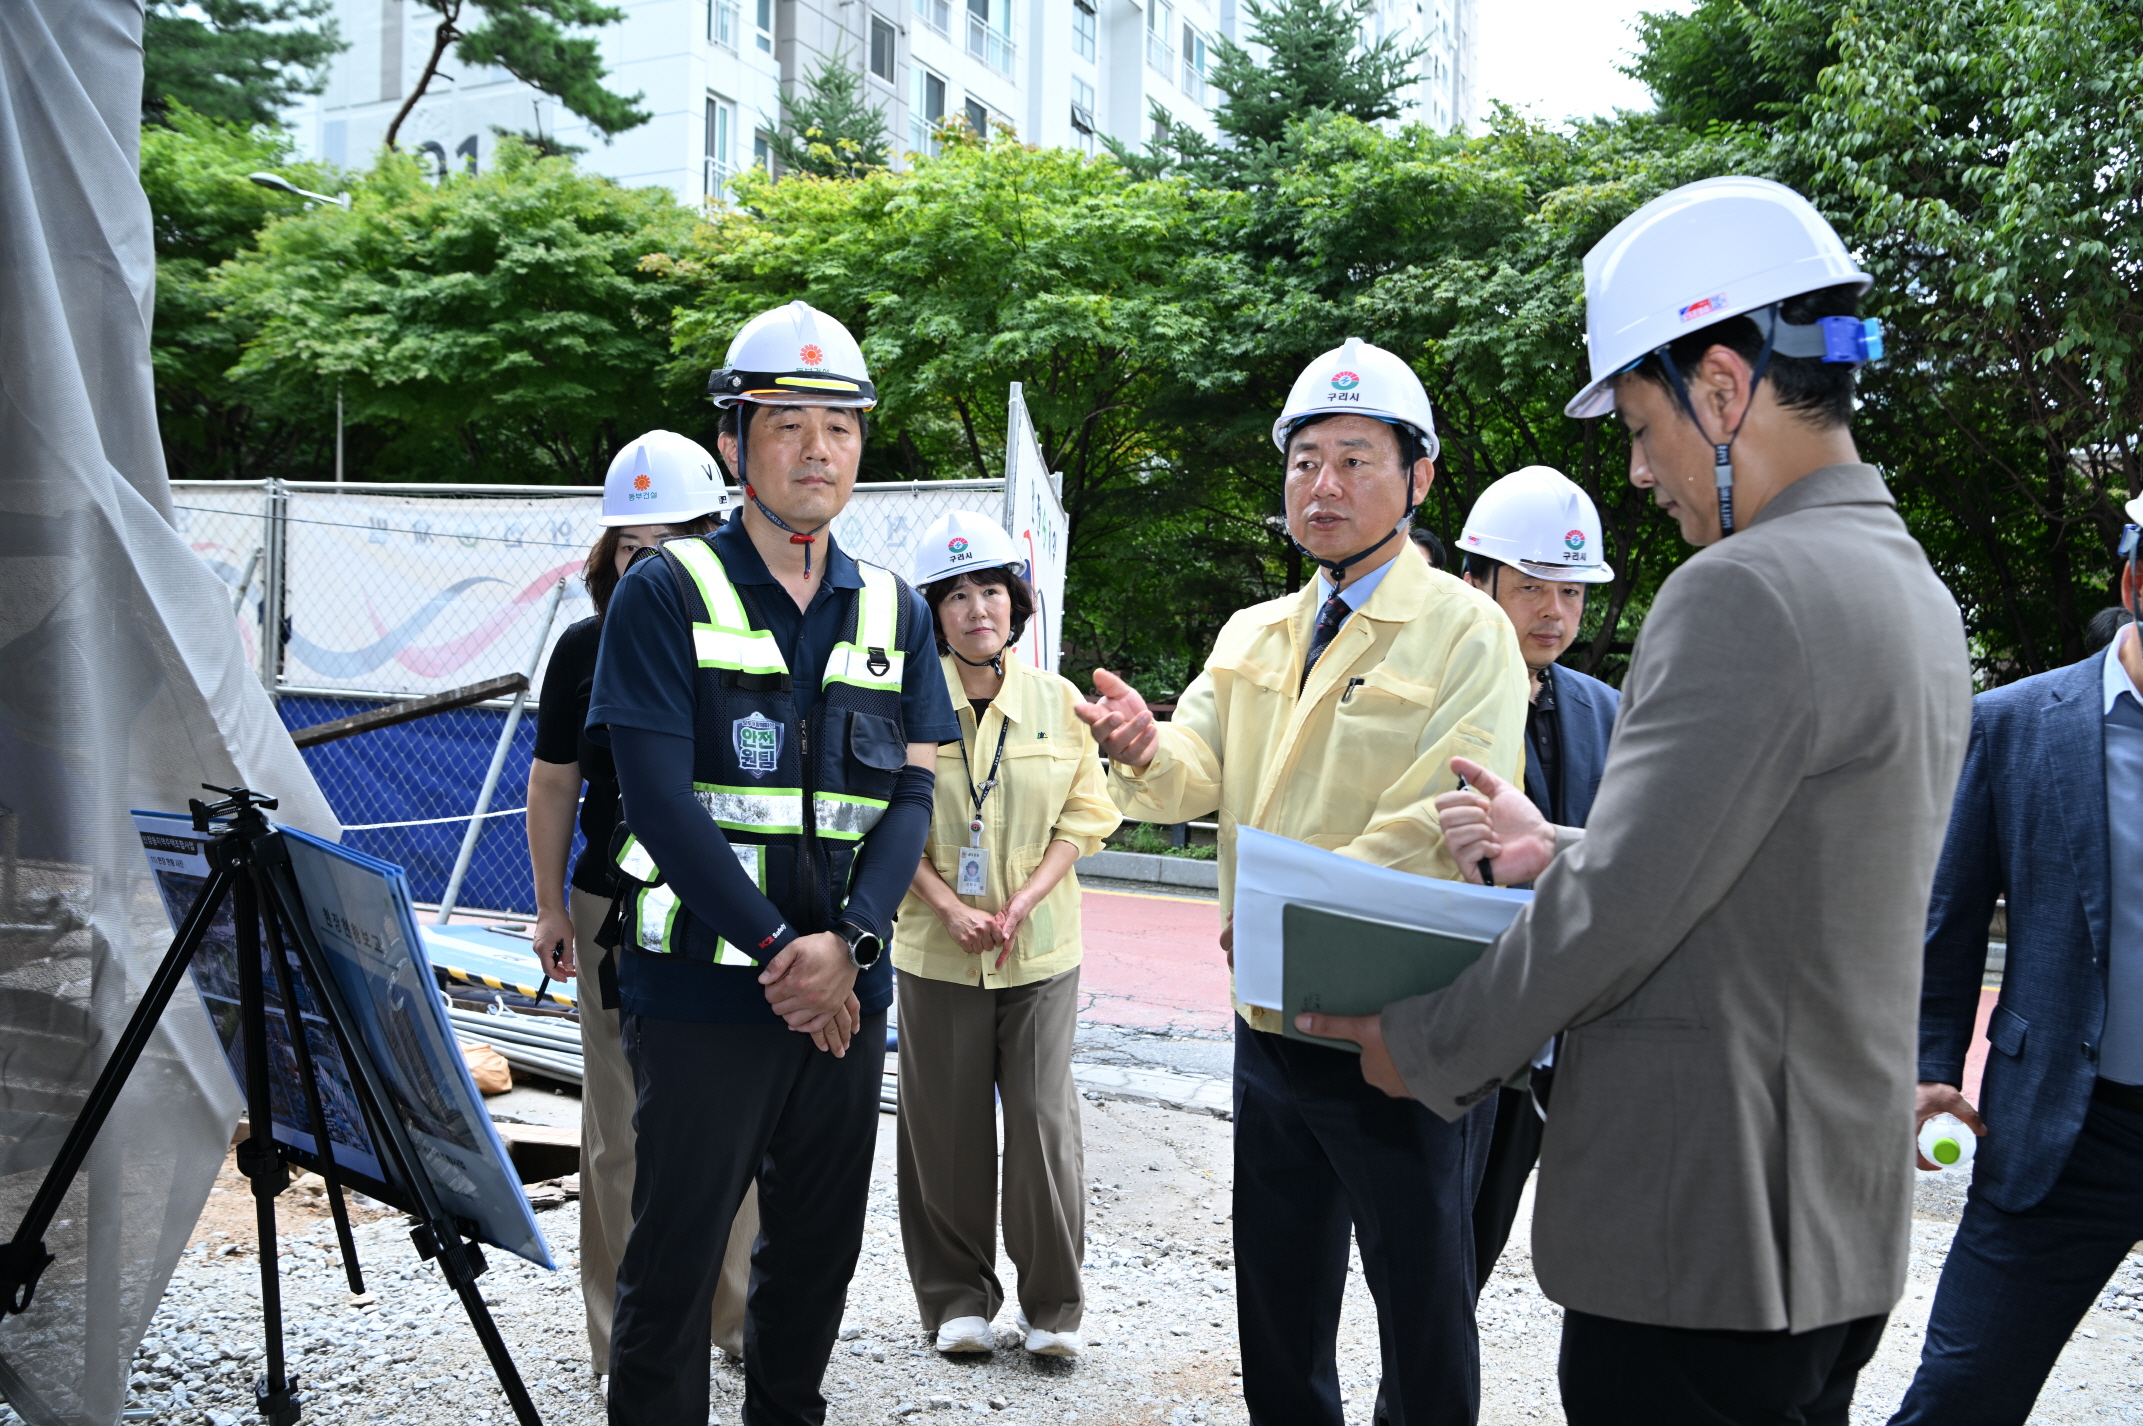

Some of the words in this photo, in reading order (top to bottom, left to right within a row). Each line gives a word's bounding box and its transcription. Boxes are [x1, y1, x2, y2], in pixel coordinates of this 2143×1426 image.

[1327, 392, 1360, 402] 구리시
[628, 491, 658, 501] 동부건설
[949, 552, 973, 563] 구리시
[1563, 551, 1587, 561] 구리시
[741, 728, 775, 749] 안전
[741, 748, 775, 769] 원팀
[323, 907, 384, 953] 현장현황보고
[758, 936, 775, 949] K2
[772, 922, 787, 939] Safety
